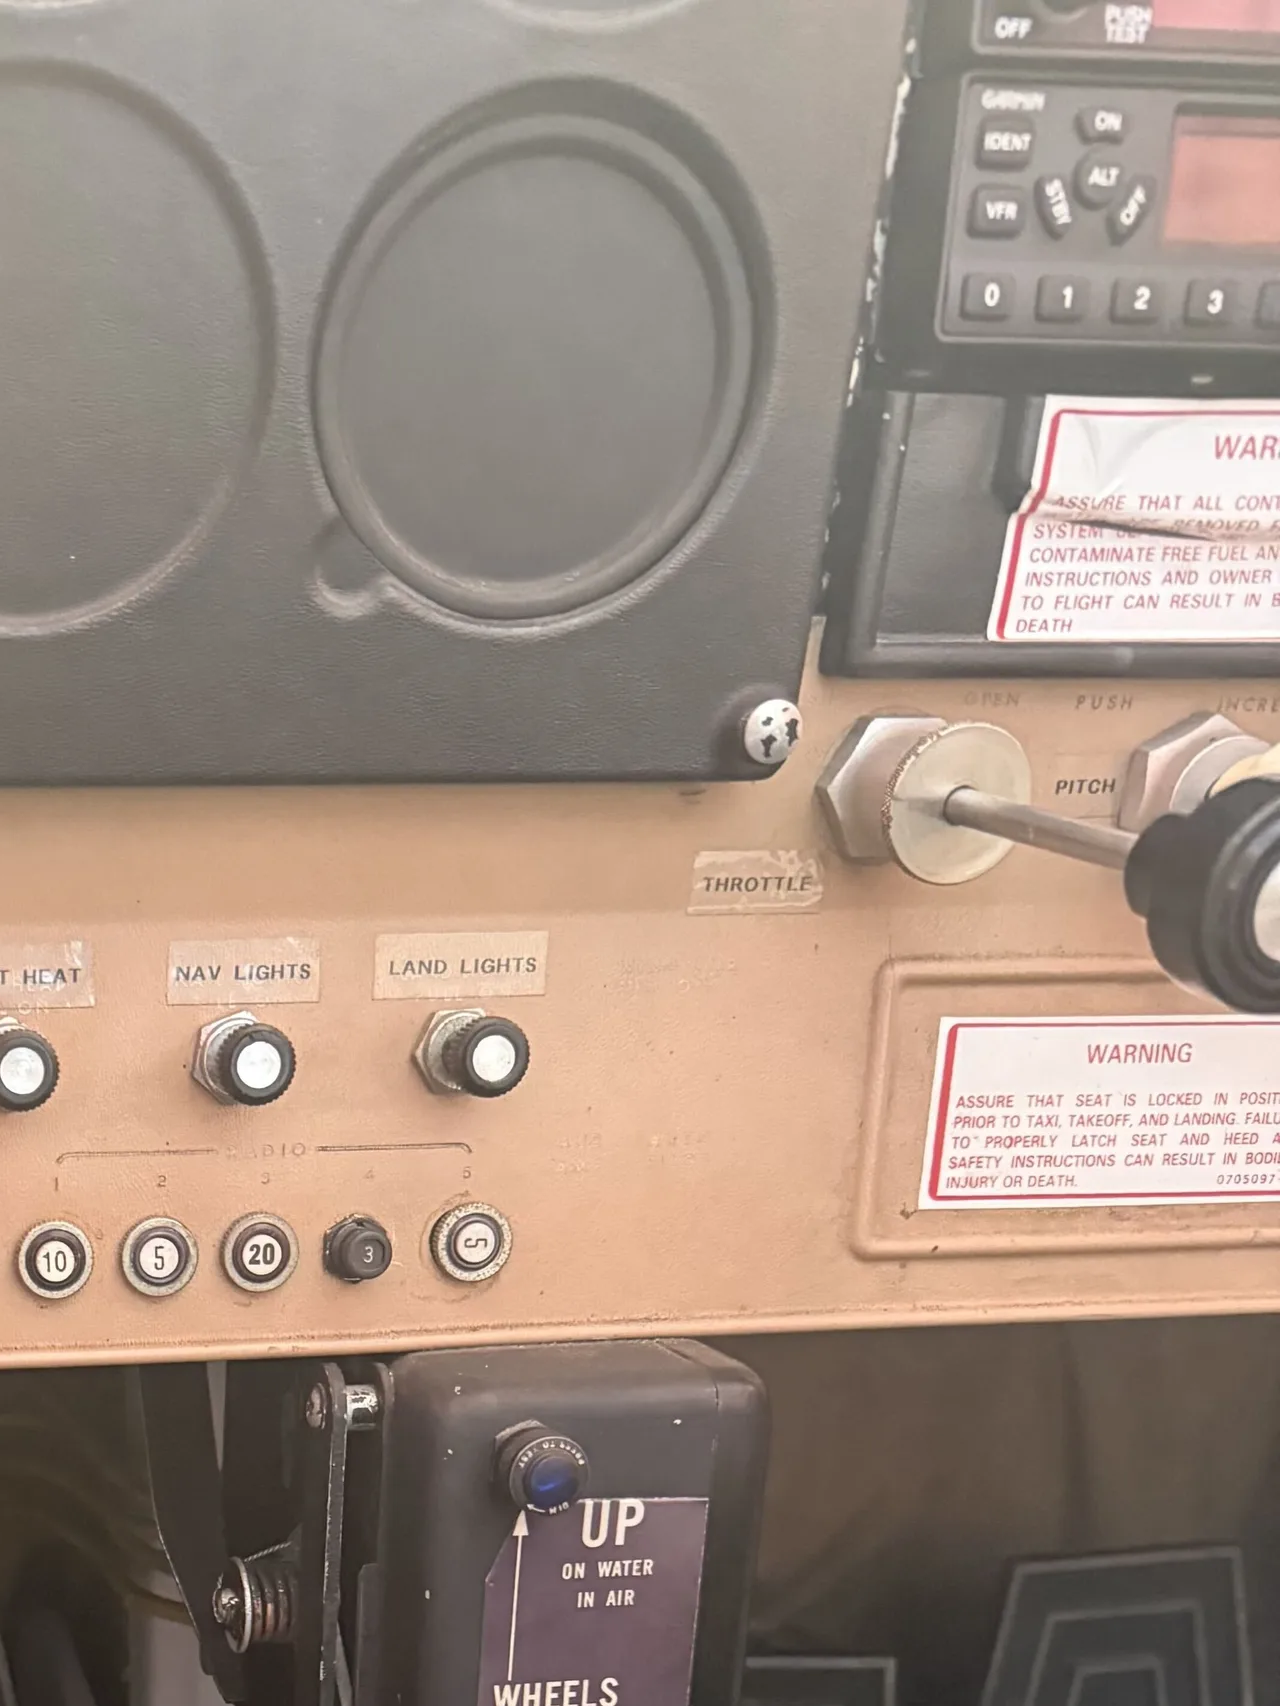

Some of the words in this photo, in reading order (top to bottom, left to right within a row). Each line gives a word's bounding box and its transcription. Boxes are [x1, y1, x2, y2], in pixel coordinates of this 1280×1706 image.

[995, 16, 1032, 38] OFF
[1094, 110, 1122, 131] ON
[983, 132, 1031, 151] IDENT
[1087, 166, 1120, 187] ALT
[986, 202, 1018, 220] VFR
[983, 281, 1000, 307] 0
[1062, 285, 1073, 309] 1
[1133, 286, 1151, 310] 2
[1207, 289, 1224, 314] 3
[1214, 435, 1280, 460] WAR
[1138, 494, 1183, 511] THAT
[1192, 494, 1224, 511] ALL
[1029, 547, 1155, 564] CONTAMINATE
[1161, 546, 1202, 562] FREE
[1207, 545, 1248, 562] FUEL
[1024, 571, 1152, 587] INSTRUCTIONS
[1161, 570, 1199, 586] AND
[1209, 569, 1273, 585] OWNER
[1020, 595, 1044, 611] TO
[1054, 595, 1114, 611] FLIGHT
[1123, 594, 1160, 610] CAN
[1169, 593, 1235, 609] RESULT
[1243, 593, 1262, 608] IN
[1015, 618, 1073, 633] DEATH
[1075, 694, 1133, 711] PUSH
[1054, 778, 1117, 796] PITCH
[702, 874, 814, 893] THROTTLE
[175, 965, 222, 982] NAV
[234, 963, 312, 981] LIGHTS
[389, 959, 448, 976] LAND
[460, 957, 537, 975] LIGHTS
[23, 968, 82, 985] HEAT
[1086, 1042, 1193, 1065] WARNING
[955, 1095, 1015, 1109] ASSURE
[1027, 1094, 1064, 1108] THAT
[1075, 1094, 1112, 1107] SEAT
[1123, 1093, 1136, 1107] IS
[1148, 1093, 1203, 1106] LOCKED
[1214, 1092, 1228, 1105] IN
[953, 1115, 996, 1130] PRIOR
[1002, 1115, 1021, 1129] TO
[1027, 1115, 1062, 1129] TAXI,
[1069, 1114, 1133, 1129] TAKEOFF,
[1139, 1113, 1169, 1127] AND
[225, 1142, 307, 1158] RDIO
[952, 1136, 971, 1149] TO
[984, 1135, 1058, 1149] PROPERLY
[1072, 1134, 1117, 1148] LATCH
[1131, 1133, 1167, 1147] SEAT
[1180, 1133, 1210, 1146] AND
[1224, 1132, 1259, 1145] HEED
[948, 1155, 1002, 1170] SAFETY
[1010, 1154, 1116, 1168] INSTRUCTIONS
[1124, 1153, 1154, 1167] CAN
[1162, 1152, 1215, 1167] RESULT
[1223, 1152, 1238, 1165] IN
[157, 1174, 168, 1188] 2
[946, 1175, 998, 1189] INJURY
[1002, 1174, 1023, 1188] OR
[1027, 1174, 1078, 1188] DEATH.
[464, 1237, 487, 1249] 5
[42, 1249, 67, 1273] 10
[153, 1245, 166, 1271] 5
[248, 1243, 276, 1265] 20
[363, 1246, 374, 1263] 3
[581, 1499, 645, 1549] UP
[562, 1561, 585, 1580] ON
[597, 1558, 654, 1579] WATER
[577, 1591, 594, 1608] IN
[606, 1589, 635, 1608] AIR
